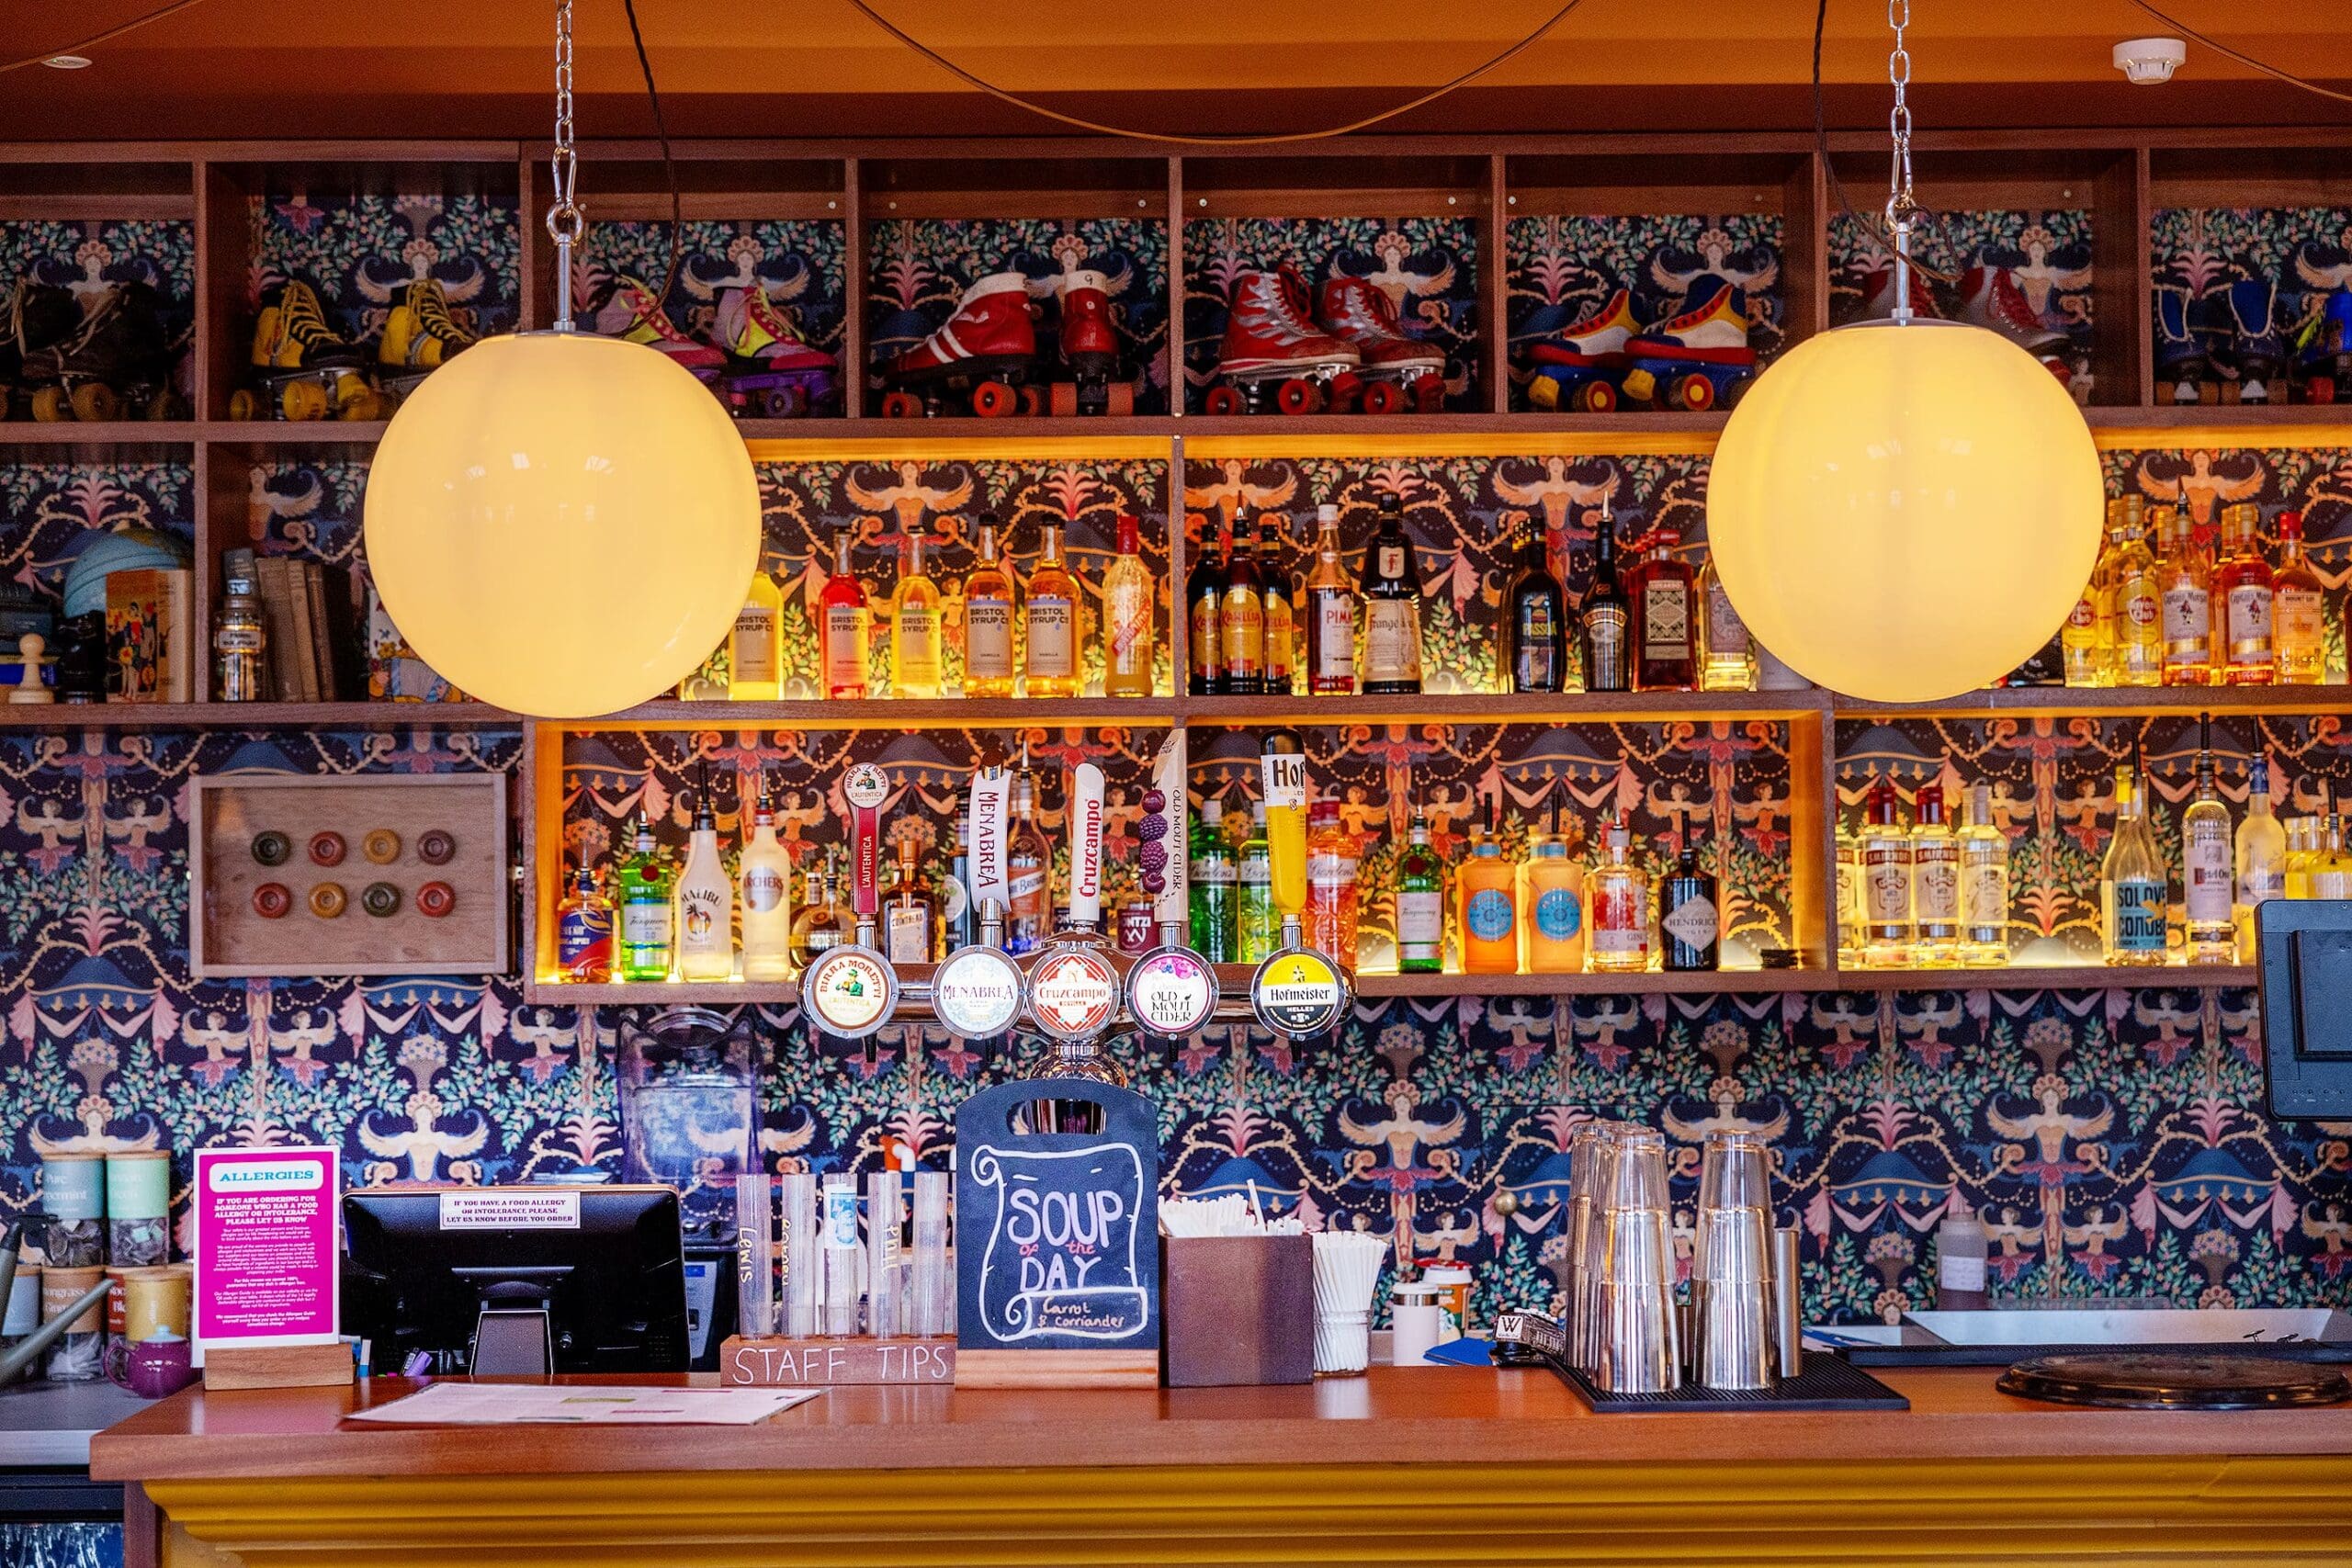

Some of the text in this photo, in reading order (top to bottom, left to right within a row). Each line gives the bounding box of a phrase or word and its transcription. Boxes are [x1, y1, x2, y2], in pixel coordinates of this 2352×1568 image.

[970, 608, 1006, 616] BRISTOL
[1029, 607, 1066, 615] BRISTOL
[831, 615, 865, 625] BRISTOL
[901, 617, 937, 626] BRISTOL
[970, 616, 997, 625] SYRUP
[1029, 615, 1057, 625] SYRUP
[735, 624, 764, 634] SYRUP
[831, 625, 860, 633] SYRUP
[901, 626, 931, 634] SYRUP
[978, 791, 1000, 889] MENABREA
[1172, 789, 1182, 890] OLD MOUT CIDER
[1079, 798, 1101, 897] Cruzcampo
[862, 835, 872, 888] L'AUTENTICA
[820, 960, 882, 999] BIRRA MORETTI
[943, 985, 1014, 1000] MENABREA
[1039, 987, 1107, 1003] Cruzcampo
[1150, 991, 1178, 1002] OLD
[1271, 987, 1330, 1002] Hofmeister
[1151, 1001, 1191, 1011] MOUT
[1150, 1011, 1192, 1022] CIDER
[220, 1170, 314, 1182] ALLERGIES
[260, 1195, 300, 1203] ORDERING
[214, 1211, 250, 1219] ALLERGY
[225, 1217, 255, 1225] PLEASE
[1007, 1189, 1124, 1248] SOUP
[738, 1226, 757, 1283] Lewis
[1019, 1241, 1096, 1257] of the
[1020, 1253, 1102, 1293] DAY
[1042, 1295, 1091, 1314] Carrot
[1055, 1314, 1125, 1328] Corriander
[1502, 1316, 1521, 1333] W
[733, 1346, 947, 1384] STAFF TIPS
